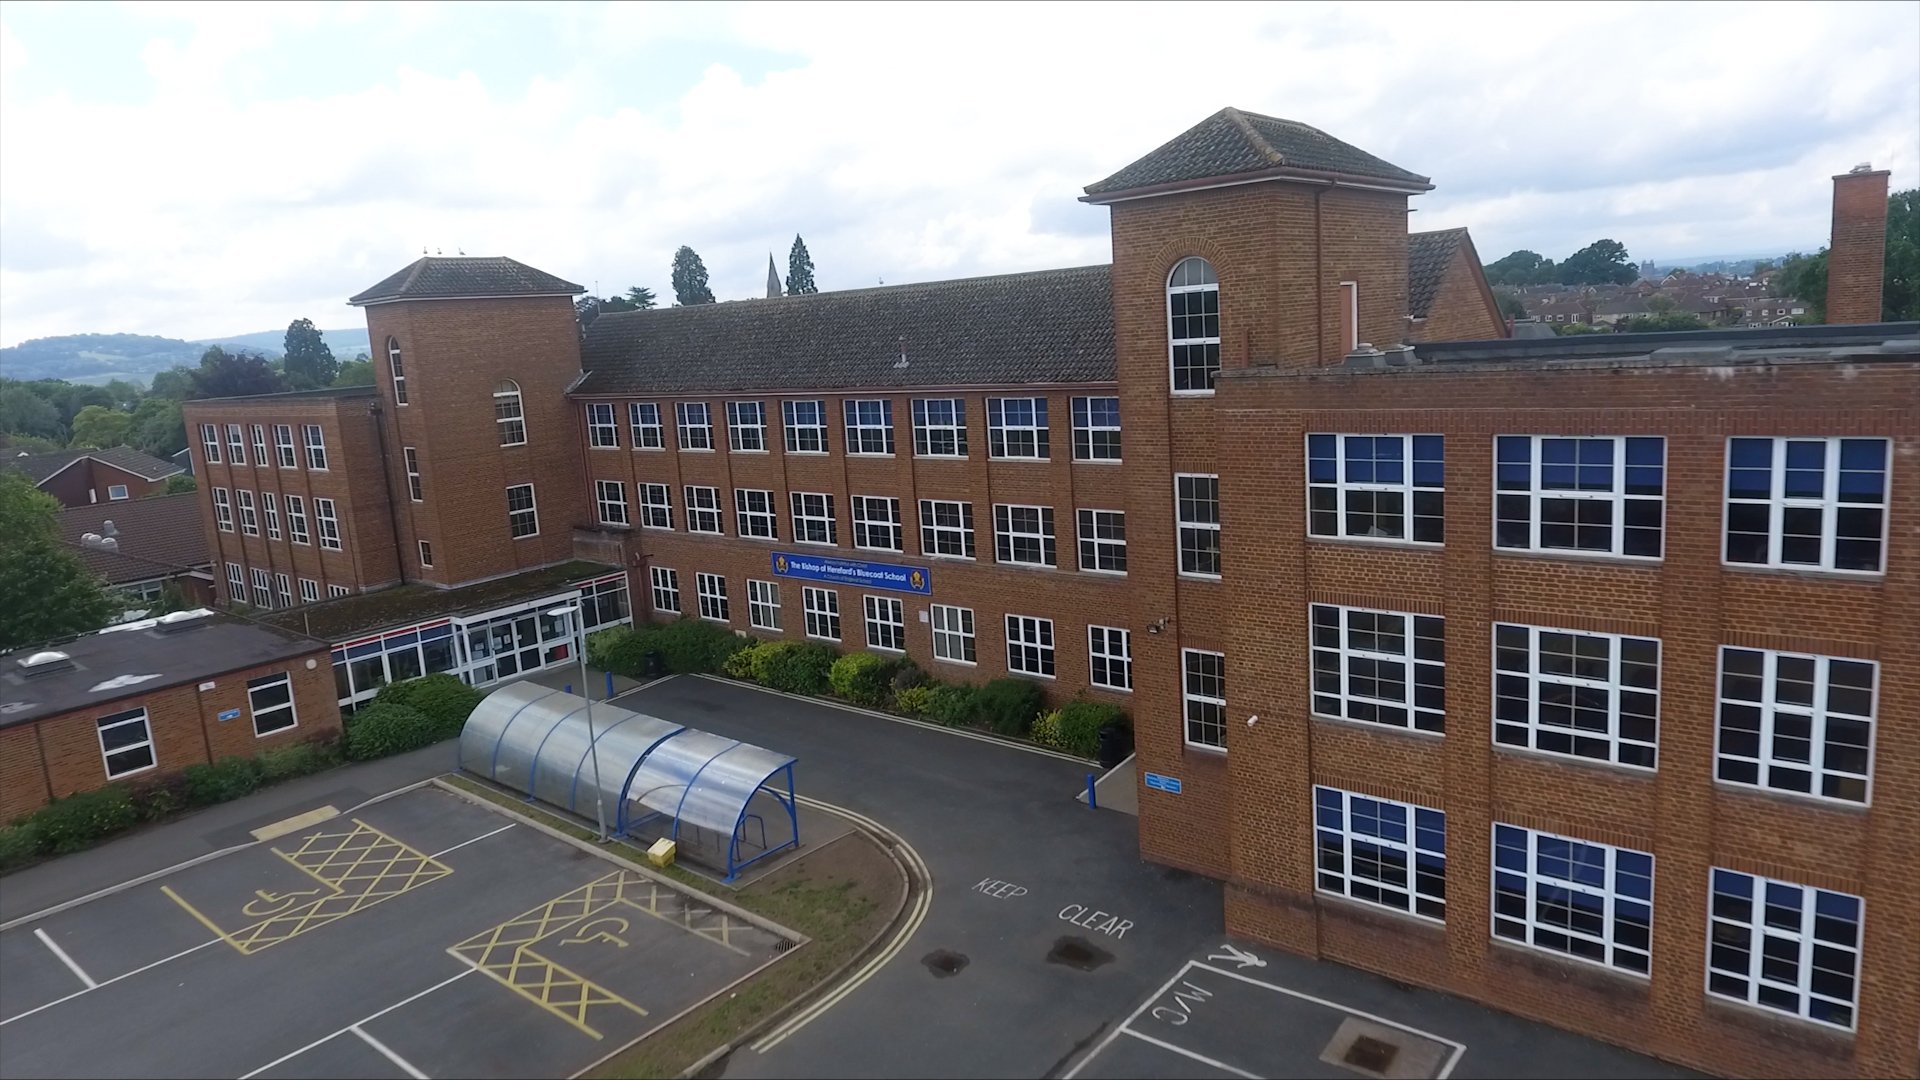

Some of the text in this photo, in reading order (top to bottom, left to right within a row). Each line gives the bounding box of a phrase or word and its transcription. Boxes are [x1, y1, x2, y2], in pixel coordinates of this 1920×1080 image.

[790, 561, 801, 570] The
[801, 562, 820, 573] Bishop
[820, 563, 827, 572] of
[827, 565, 856, 576] Hereford's
[857, 568, 883, 579] Bluecoat
[884, 572, 907, 582] School
[971, 877, 1028, 899] KEEP
[1057, 903, 1134, 939] CLEAR
